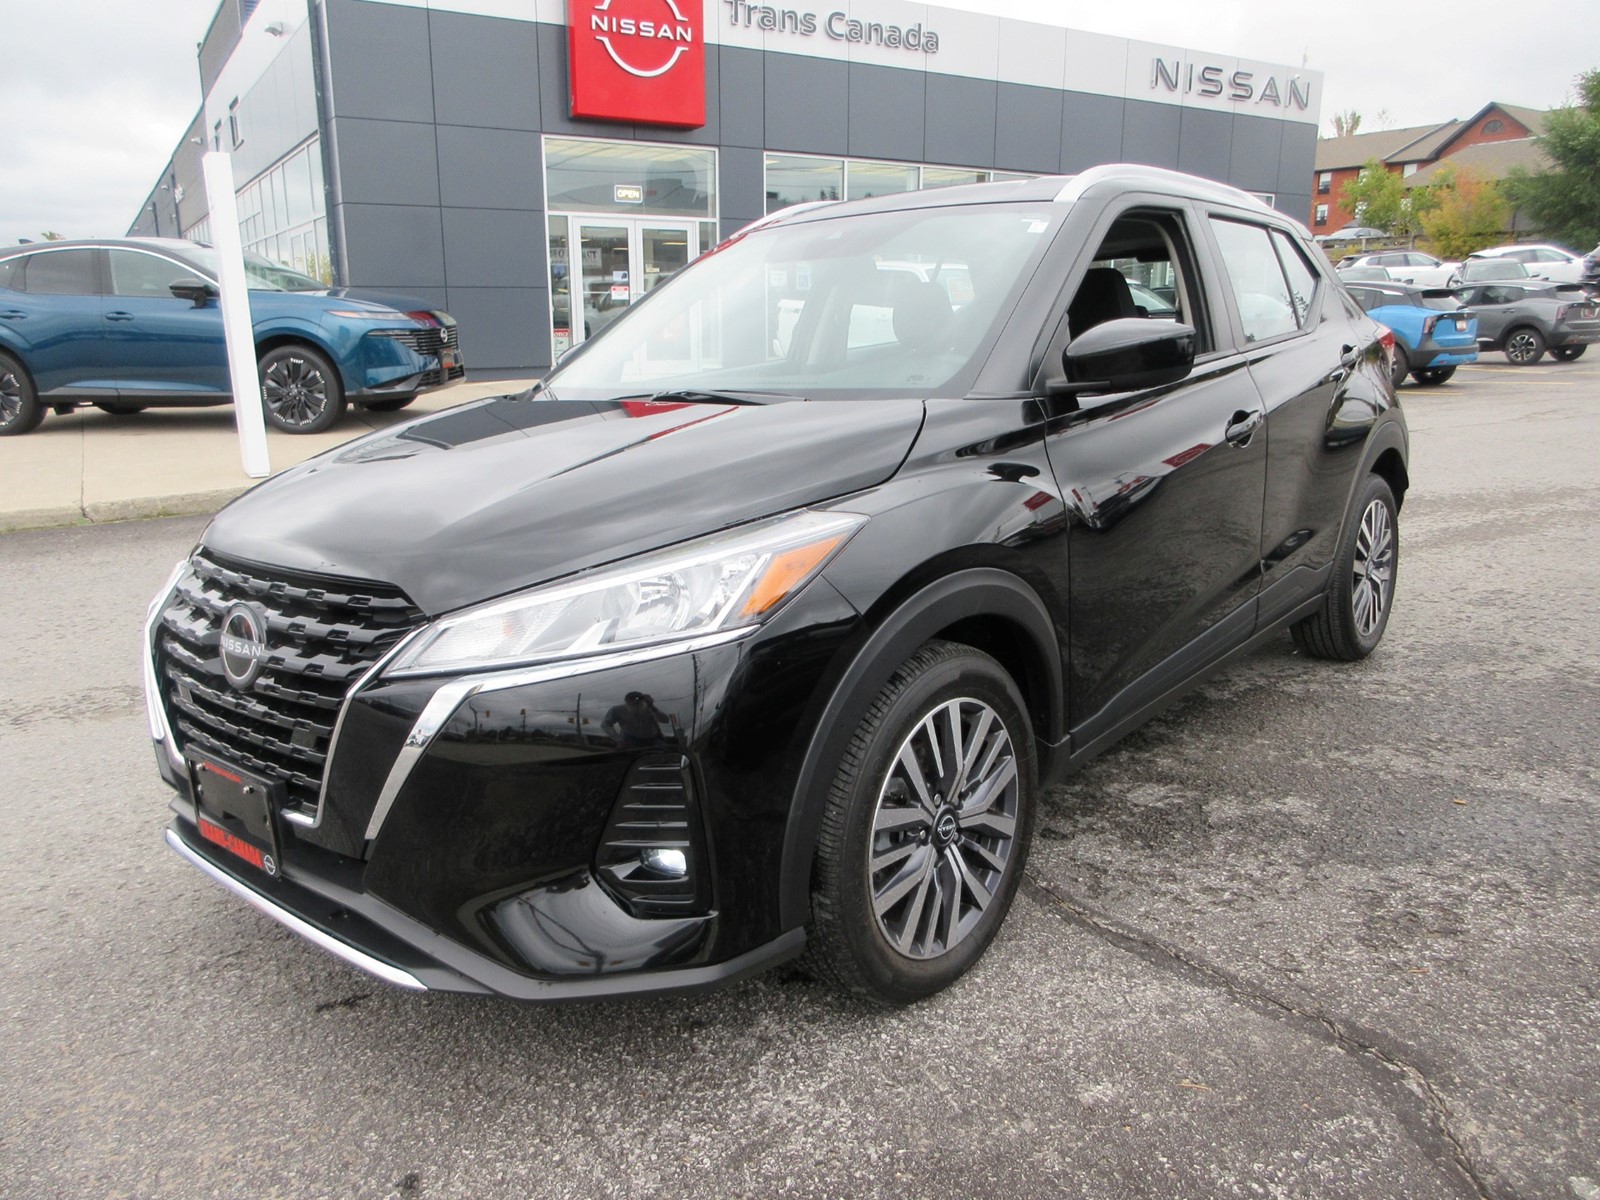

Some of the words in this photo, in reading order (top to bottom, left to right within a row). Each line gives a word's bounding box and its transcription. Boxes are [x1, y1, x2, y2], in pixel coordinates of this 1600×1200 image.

[591, 13, 692, 43] NISSAN
[724, 0, 817, 35] Trans
[825, 11, 939, 53] Canada
[1151, 57, 1310, 111] NISSAN
[617, 189, 640, 199] OPEN
[221, 634, 261, 657] NISSAN
